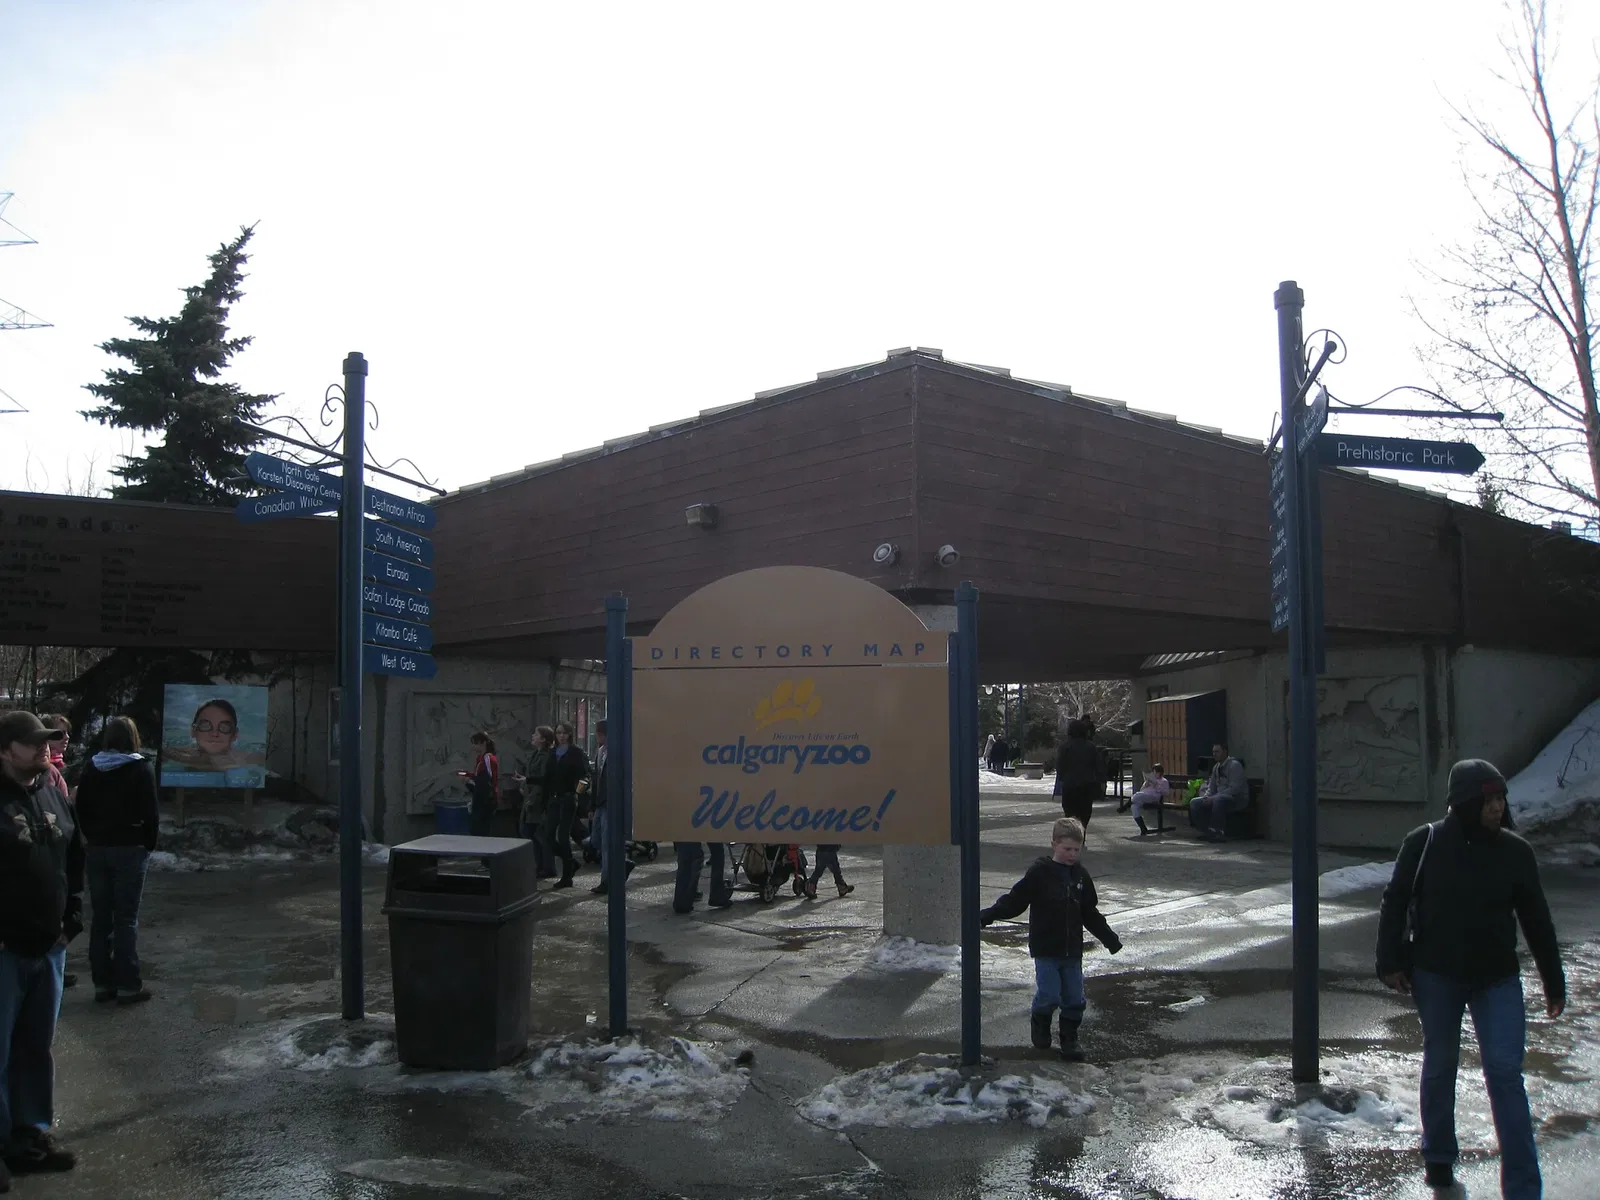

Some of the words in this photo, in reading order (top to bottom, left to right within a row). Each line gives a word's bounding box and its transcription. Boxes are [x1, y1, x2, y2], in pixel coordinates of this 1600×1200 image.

[1337, 442, 1414, 463] Prehistoric
[1423, 448, 1455, 466] Park
[257, 466, 284, 485] Karsten
[285, 475, 319, 497] Discovery
[320, 485, 342, 501] Centre
[282, 462, 302, 478] North
[304, 469, 320, 483] Gate
[254, 498, 295, 516] Canadian
[371, 495, 405, 517] Destination
[406, 506, 426, 524] Africa
[375, 528, 394, 546] South
[396, 535, 421, 556] America
[386, 562, 409, 582] Eurasia
[364, 586, 383, 604] Safari
[385, 592, 405, 614] Lodge
[408, 597, 430, 616] Canada
[381, 653, 397, 669] West
[400, 656, 417, 672] Gate
[651, 643, 834, 661] DIRECTORY
[863, 642, 926, 658] MAP
[772, 732, 805, 742] Discover
[807, 732, 823, 743] Life
[824, 734, 836, 742] on
[836, 732, 860, 742] Earth
[691, 786, 896, 833] Welcome!
